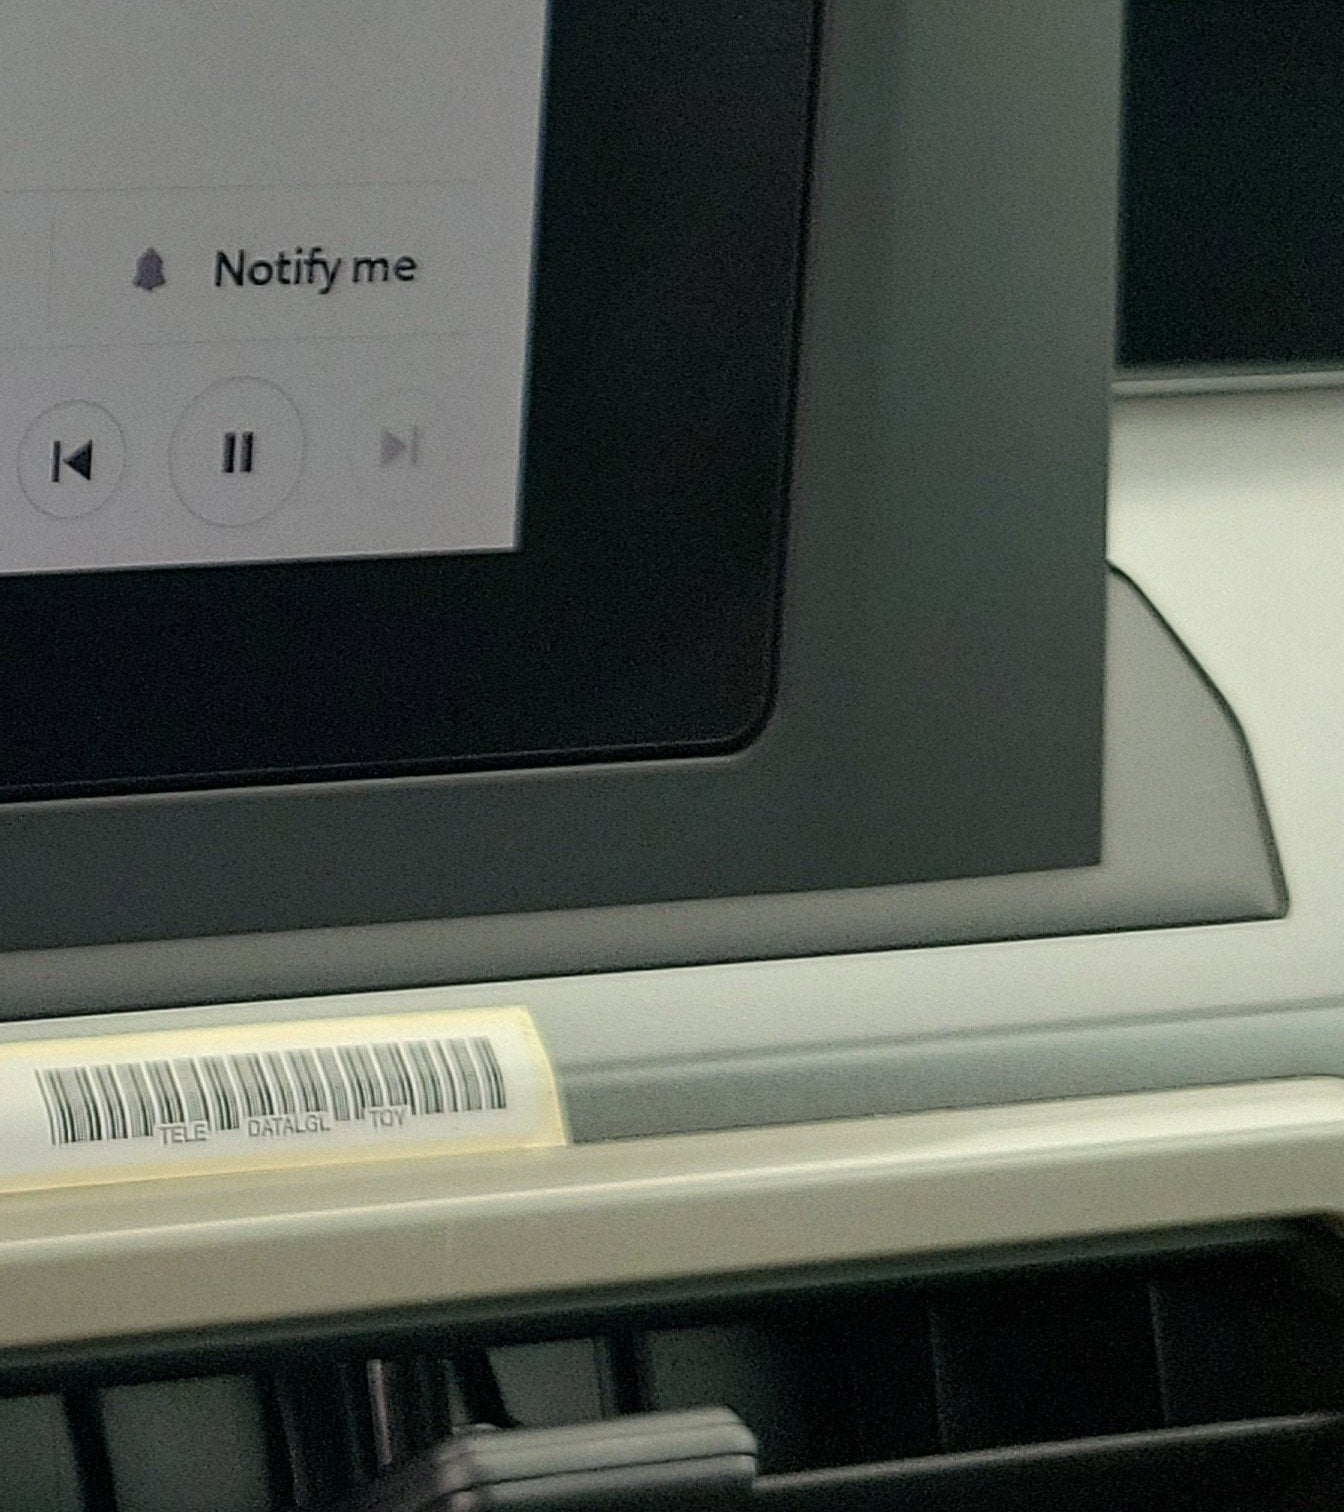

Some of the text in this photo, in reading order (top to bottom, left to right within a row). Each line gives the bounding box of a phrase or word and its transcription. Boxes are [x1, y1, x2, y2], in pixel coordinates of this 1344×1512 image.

[214, 245, 418, 296] Notify me
[159, 1123, 207, 1144] TELE
[369, 1105, 408, 1129] TOY
